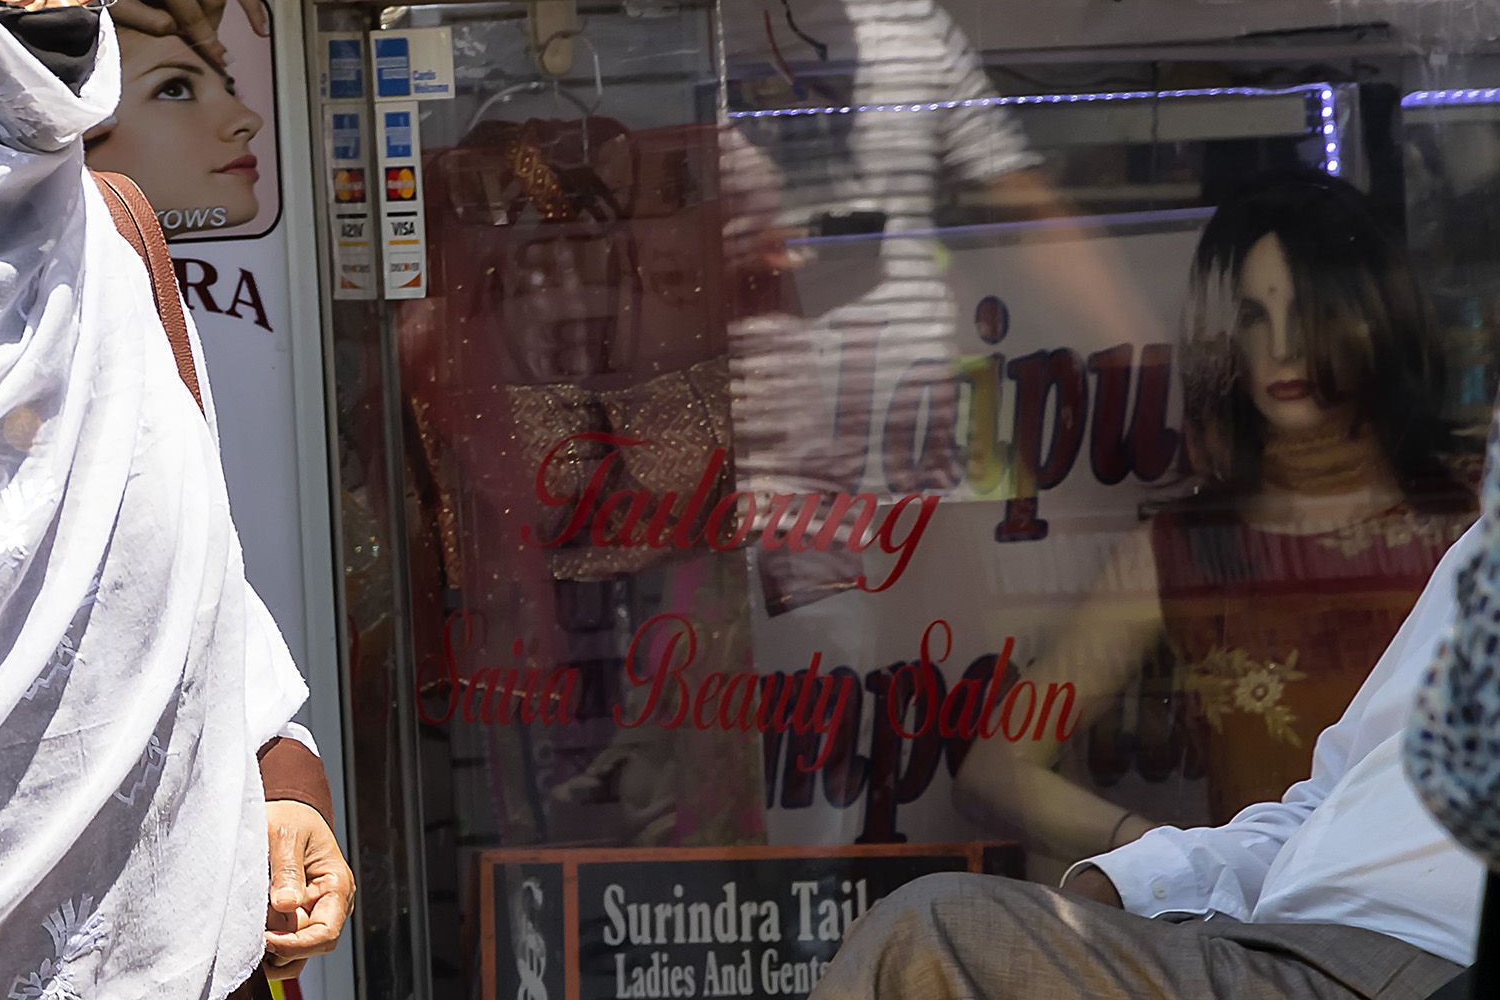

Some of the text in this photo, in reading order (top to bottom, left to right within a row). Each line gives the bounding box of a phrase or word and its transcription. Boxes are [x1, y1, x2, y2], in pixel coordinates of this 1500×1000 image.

[156, 207, 227, 229] rows
[391, 222, 415, 236] VISA
[171, 258, 274, 333] RA
[822, 295, 1192, 543] Jaipu
[521, 431, 942, 594] Tailoring
[613, 613, 858, 774] Beauty
[887, 619, 1083, 744] Salon
[603, 878, 868, 946] Surindra Tail
[614, 952, 696, 1000] Ladies
[703, 950, 752, 997] And
